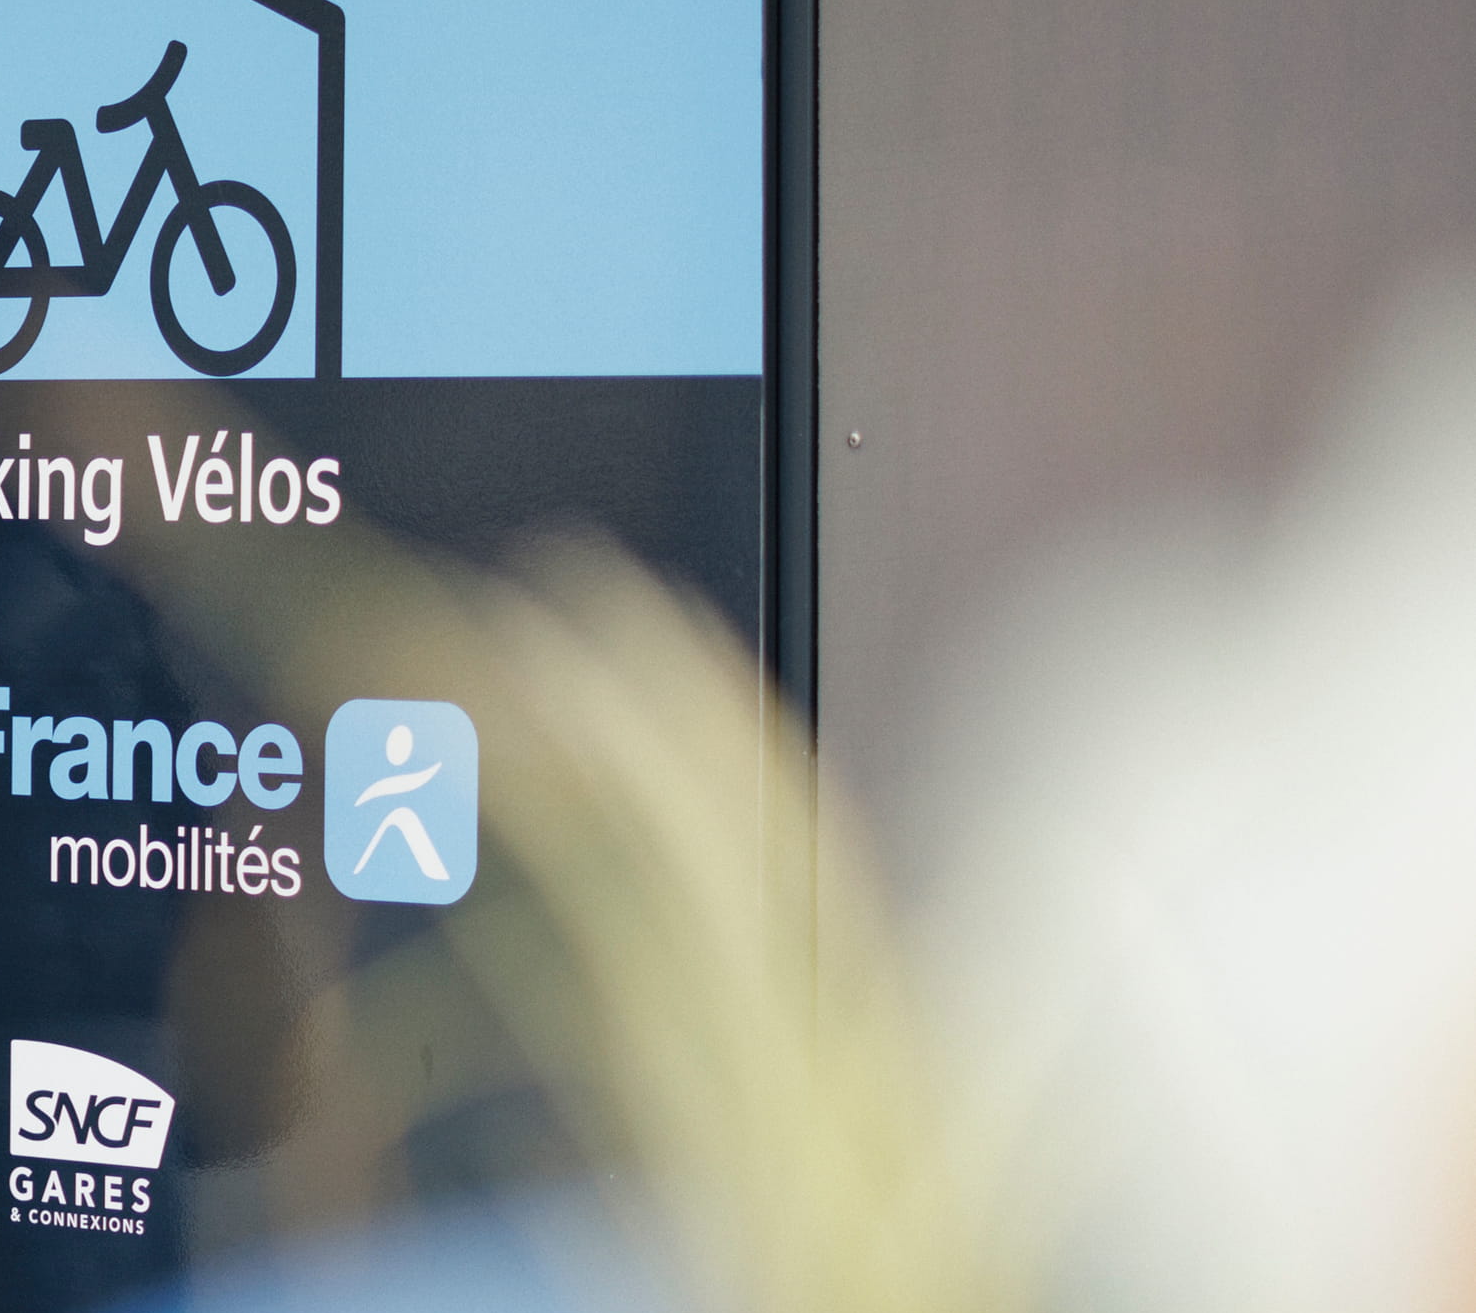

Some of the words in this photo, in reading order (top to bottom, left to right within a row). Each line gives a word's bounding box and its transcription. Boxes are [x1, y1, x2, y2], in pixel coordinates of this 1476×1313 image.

[146, 430, 341, 525] Vélos
[50, 824, 302, 897] mobilités
[18, 1089, 162, 1149] SNCF
[9, 1166, 152, 1214] GARES
[10, 1206, 21, 1223] &
[28, 1208, 145, 1235] CONNEXIONS
